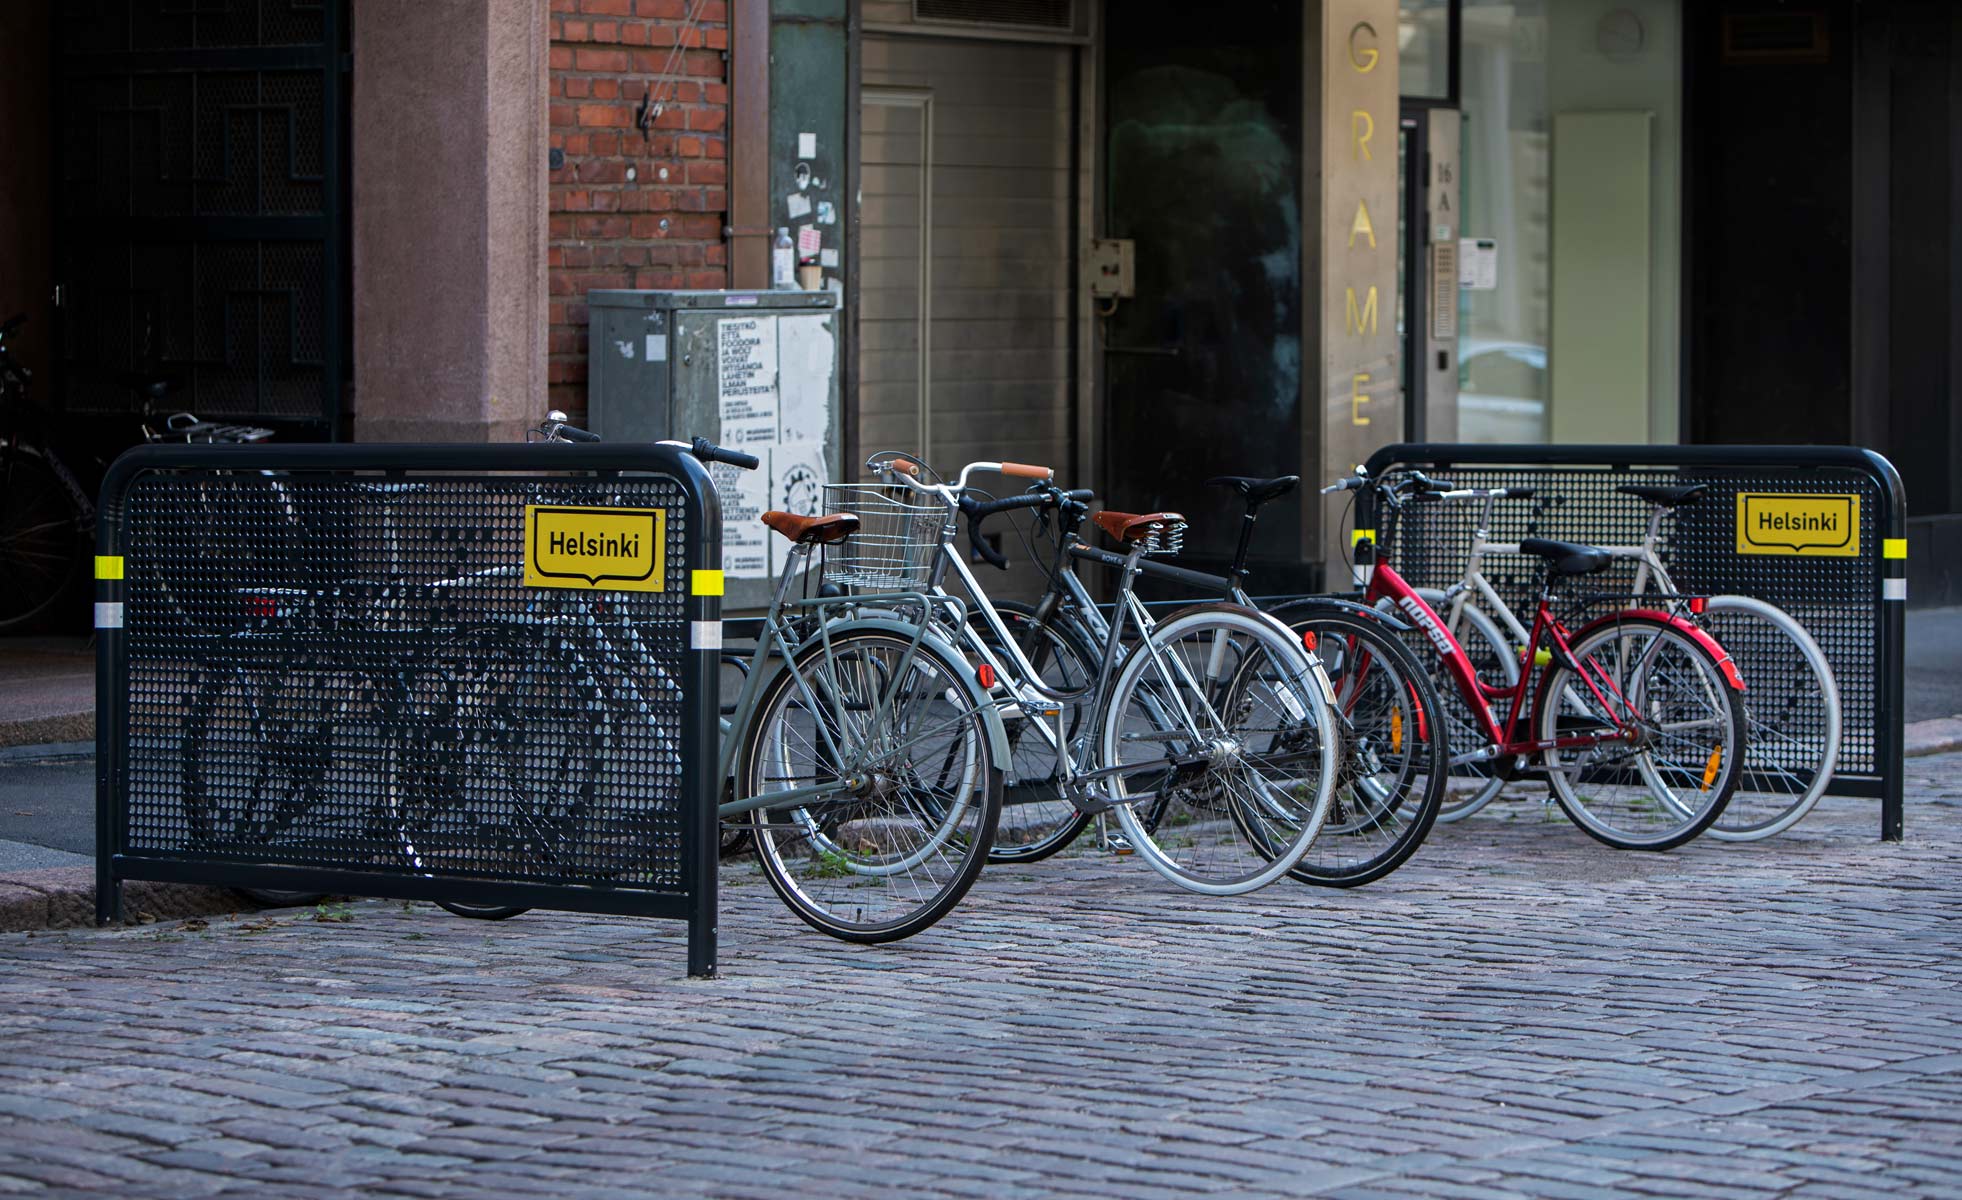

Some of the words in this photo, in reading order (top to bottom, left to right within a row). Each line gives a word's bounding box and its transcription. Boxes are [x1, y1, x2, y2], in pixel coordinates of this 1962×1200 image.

[1438, 193, 1450, 212] A
[1347, 20, 1380, 426] GRAME
[1759, 512, 1837, 531] Helsinki
[550, 531, 639, 558] Helsinki
